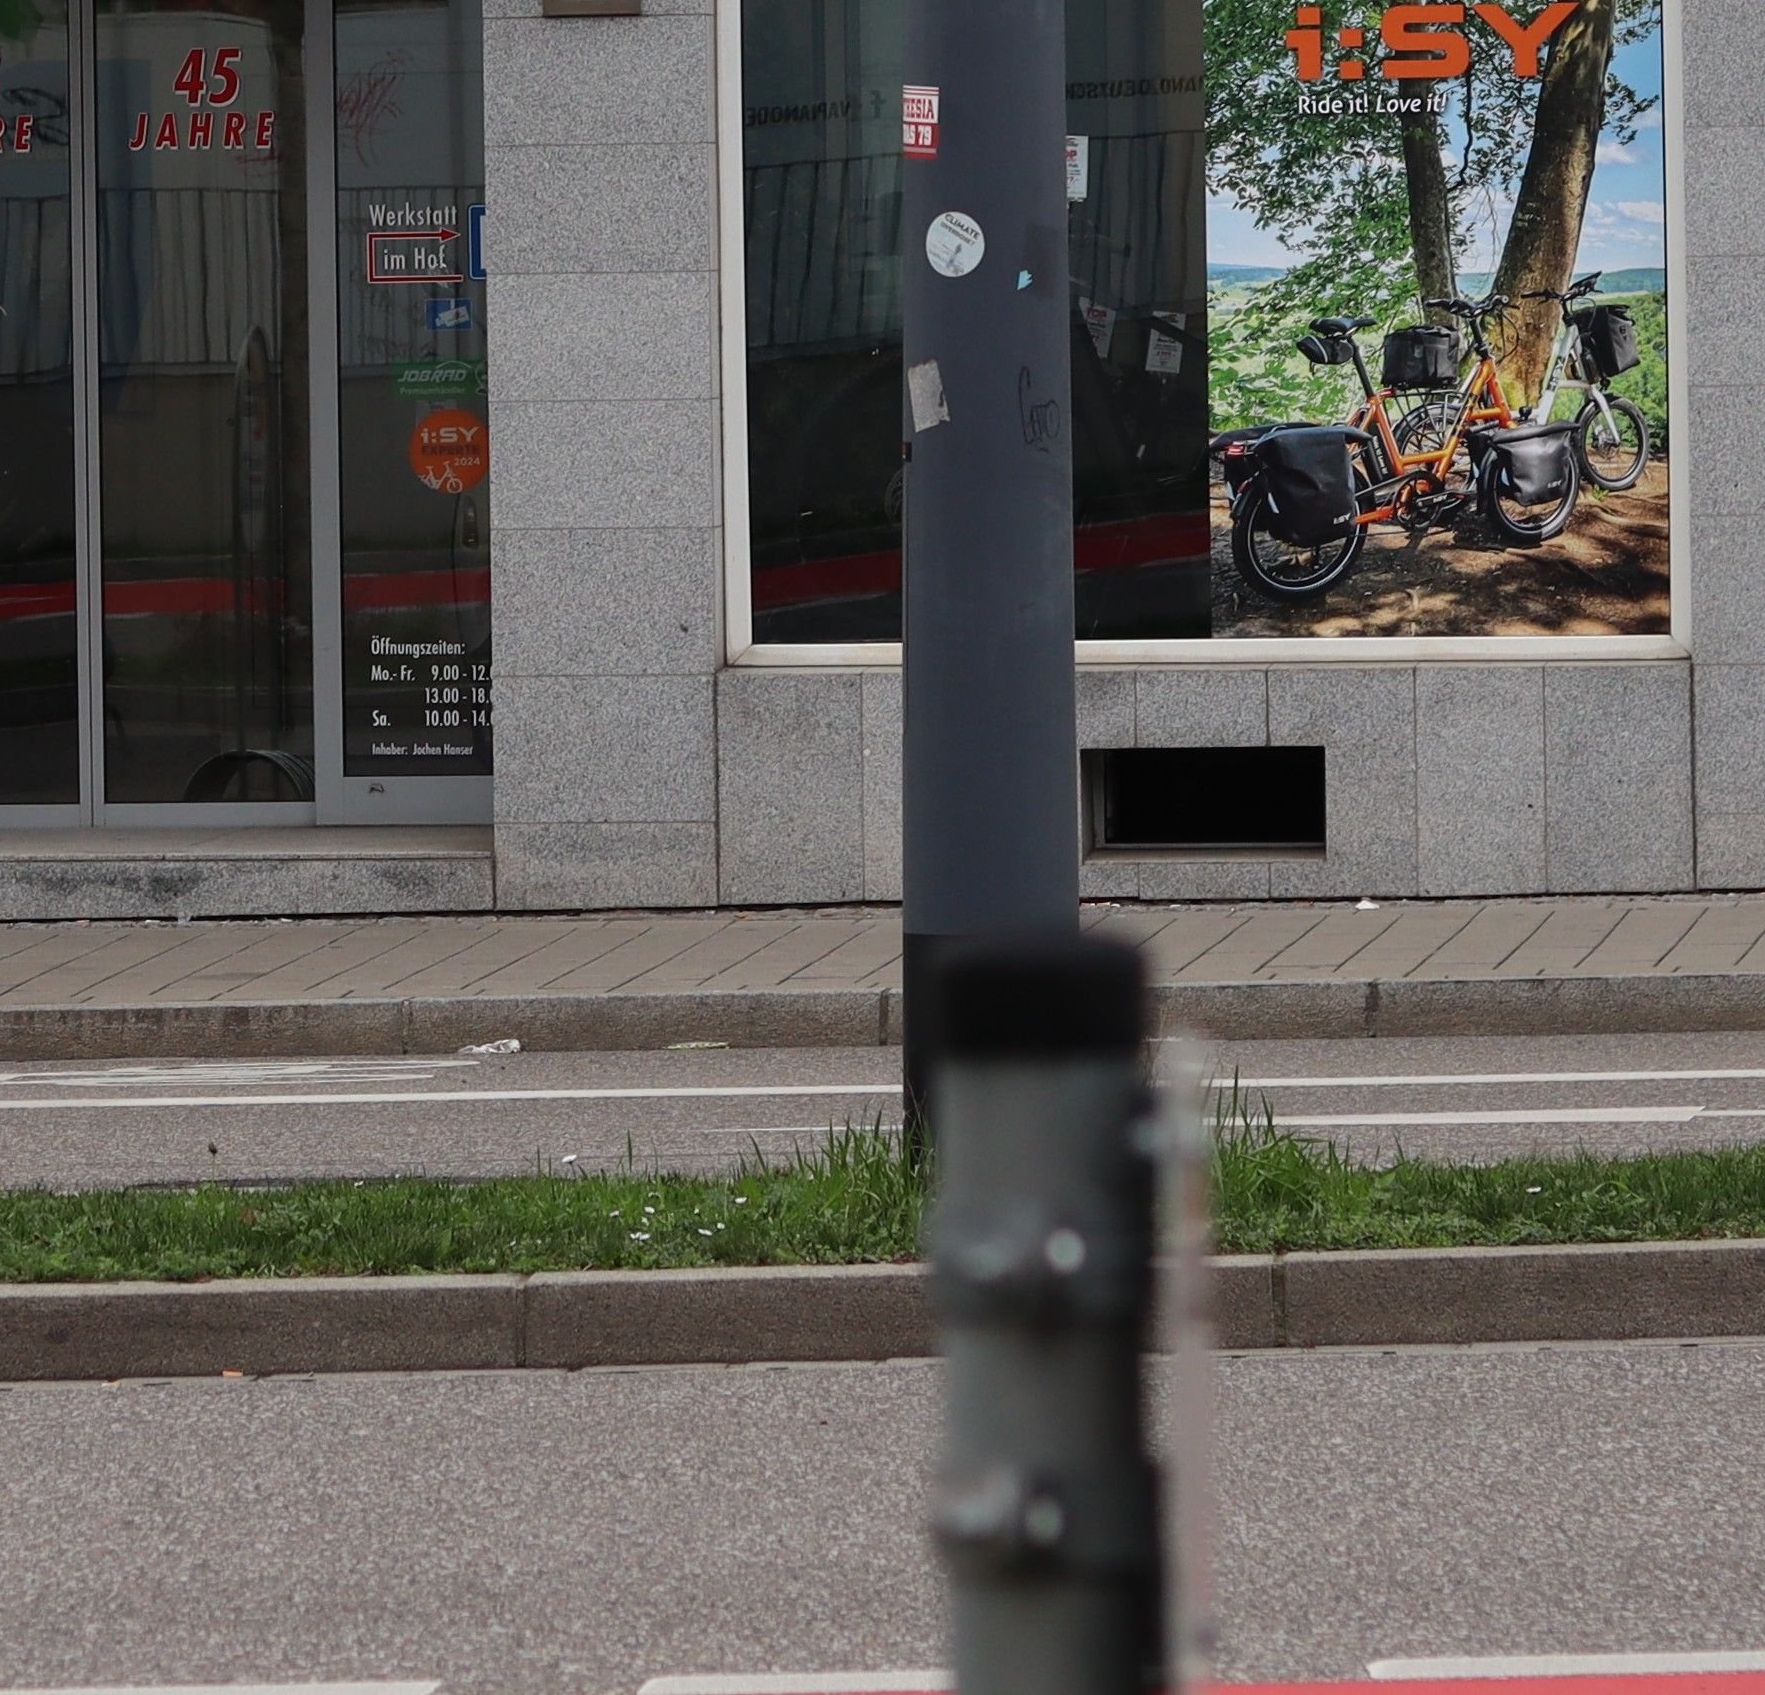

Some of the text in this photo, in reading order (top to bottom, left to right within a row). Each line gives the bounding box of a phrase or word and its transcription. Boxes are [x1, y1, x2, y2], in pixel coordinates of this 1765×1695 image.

[1286, 2, 1579, 81] i:SY
[173, 47, 242, 108] 45
[1298, 93, 1448, 114] Ride it! Love it!
[129, 110, 276, 151] JAHRE
[918, 125, 933, 145] 79
[369, 202, 458, 227] Werkstatt
[945, 213, 981, 240] CLIMATE
[383, 244, 448, 270] im Hof
[397, 369, 467, 383] JOBRAD
[420, 426, 480, 443] i:SY
[371, 635, 466, 658] Öffnungszeiten:
[431, 665, 459, 681] 9.00
[472, 665, 492, 681] 12.
[425, 687, 459, 704] 13.00
[472, 687, 492, 704] 18.
[372, 709, 391, 726] Sa.
[425, 709, 459, 726] 10.00
[472, 709, 492, 726] 14.
[372, 742, 473, 755] Inhaber: Jochen Hanser
